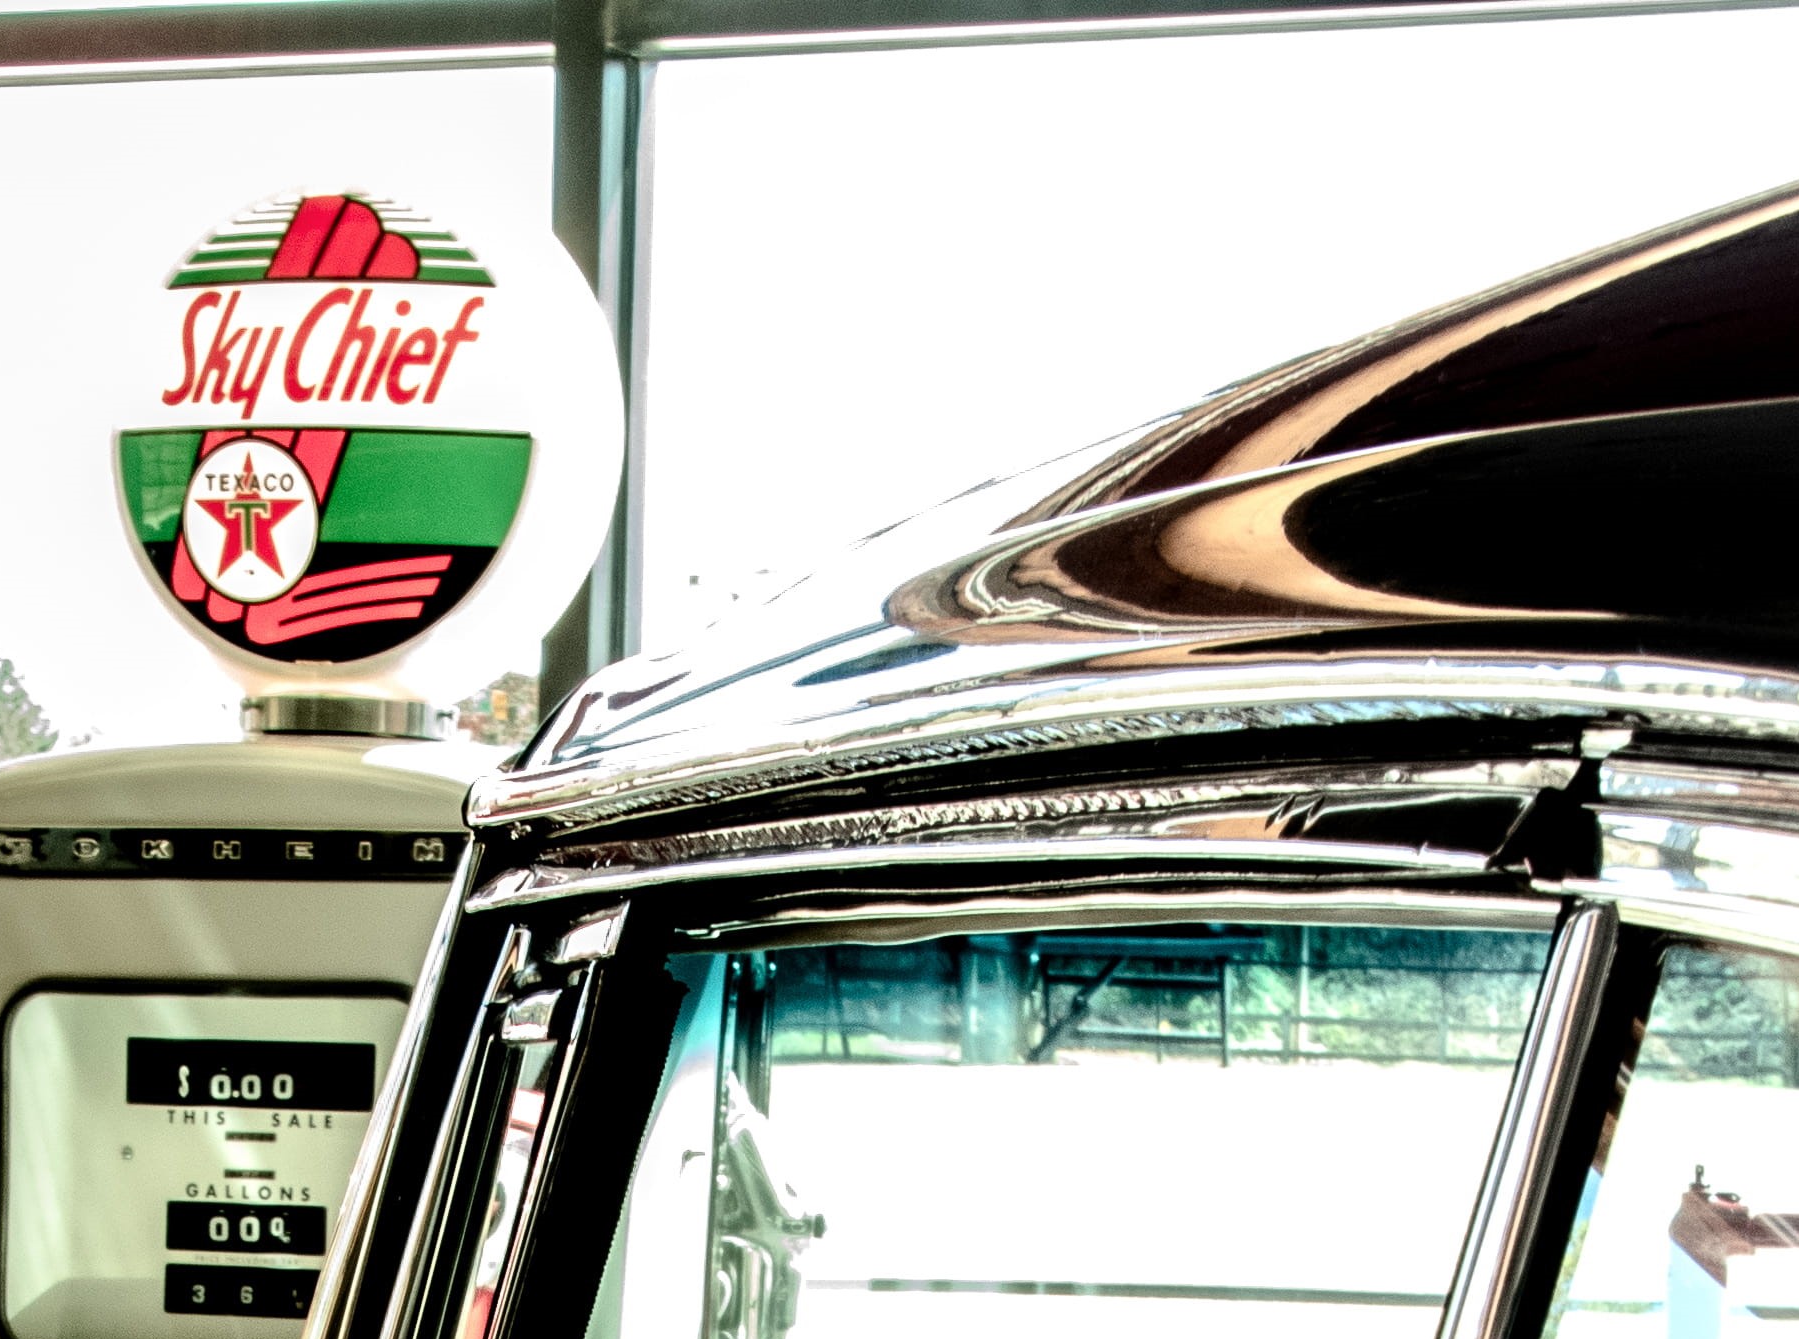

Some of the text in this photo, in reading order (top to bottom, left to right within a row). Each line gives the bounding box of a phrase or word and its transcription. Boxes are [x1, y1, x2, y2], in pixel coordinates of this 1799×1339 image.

[161, 287, 485, 420] Sky Chief
[205, 472, 295, 494] TEXACO
[167, 1110, 334, 1129] THIS SALE
[185, 1183, 311, 1201] GALLONS
